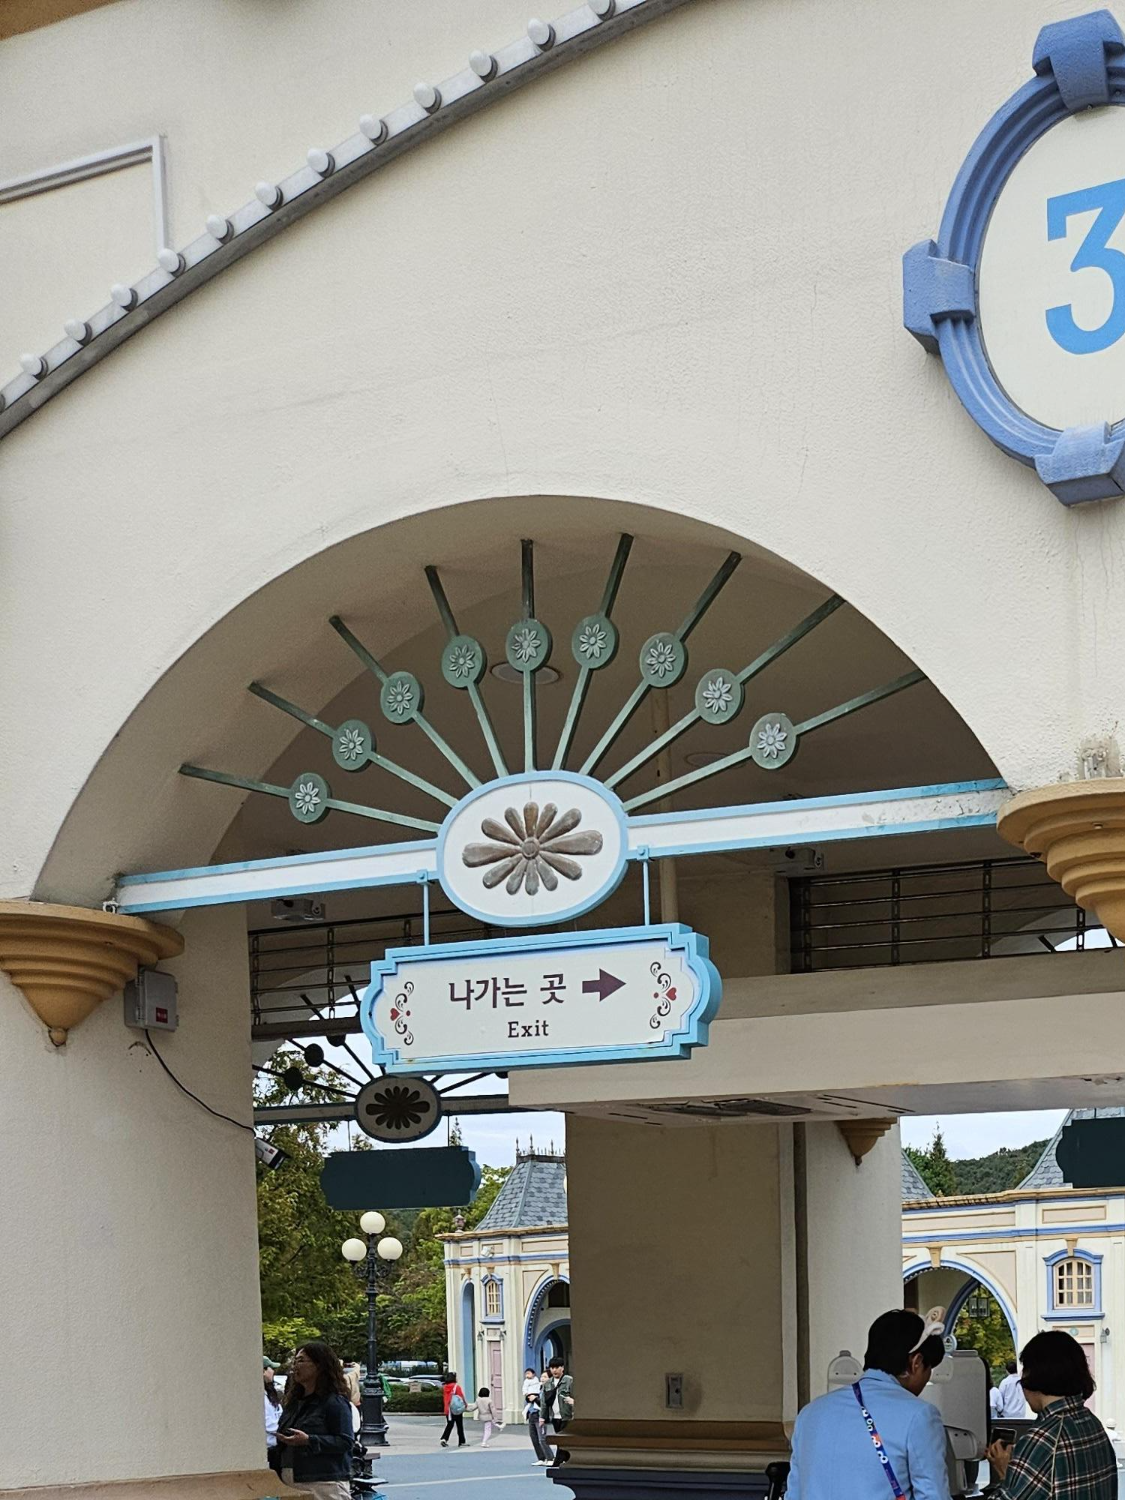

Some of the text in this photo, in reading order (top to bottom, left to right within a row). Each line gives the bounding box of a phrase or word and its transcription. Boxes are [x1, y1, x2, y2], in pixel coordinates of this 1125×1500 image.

[448, 973, 567, 1010] 나가는 곳
[507, 1020, 549, 1038] Exit
